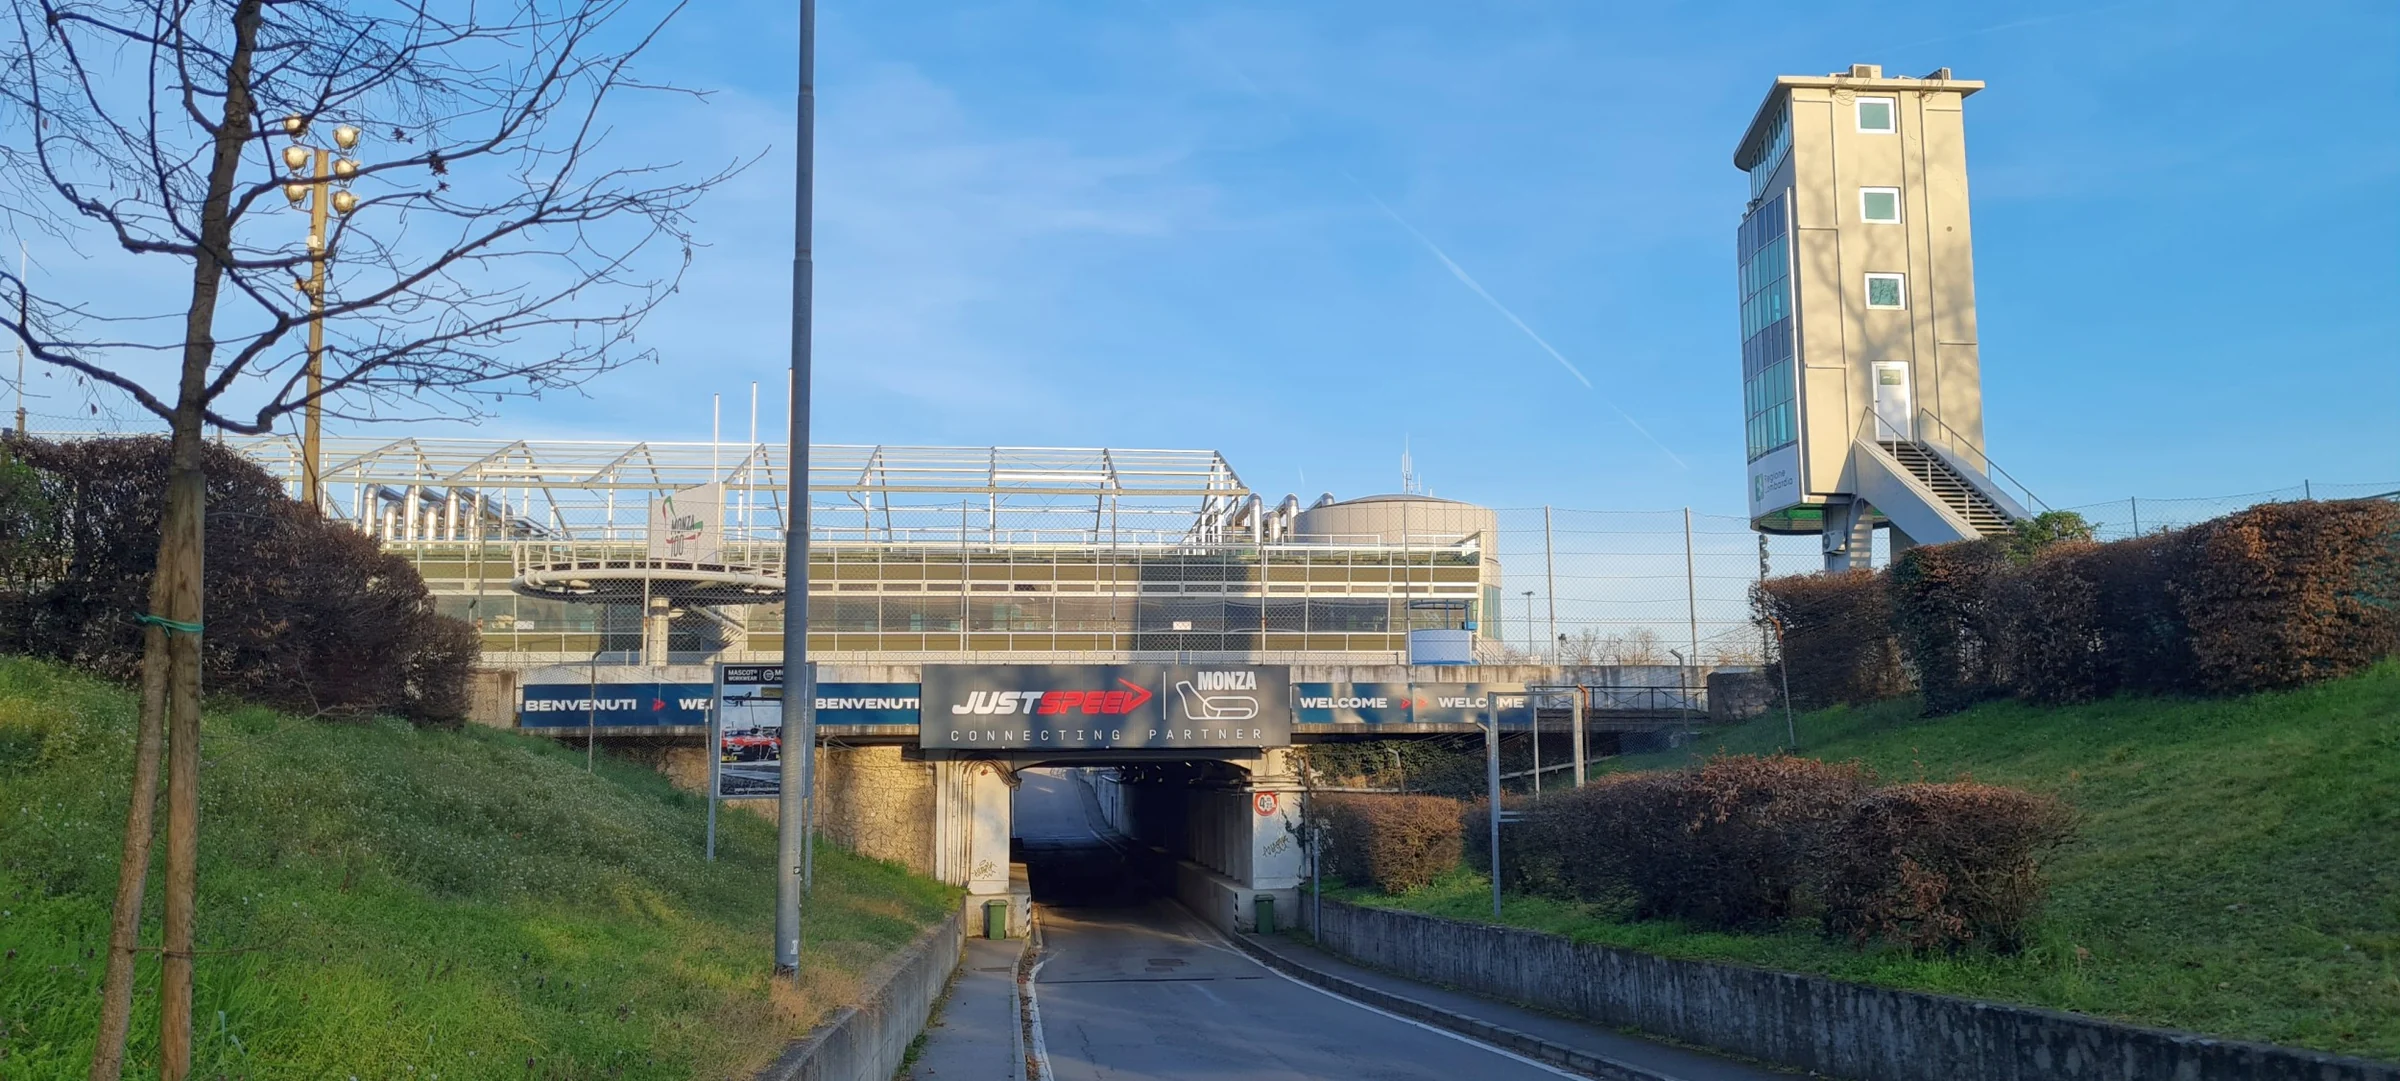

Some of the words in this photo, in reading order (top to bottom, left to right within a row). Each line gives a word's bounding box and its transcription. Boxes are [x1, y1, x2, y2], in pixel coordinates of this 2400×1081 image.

[1197, 671, 1258, 691] MONZA
[525, 698, 637, 712] BENVENUTI
[815, 698, 920, 710] BENVENUTI
[1299, 697, 1388, 709] WELCOME
[950, 729, 1121, 742] CONNECTING
[1148, 728, 1263, 741] PARTNER
